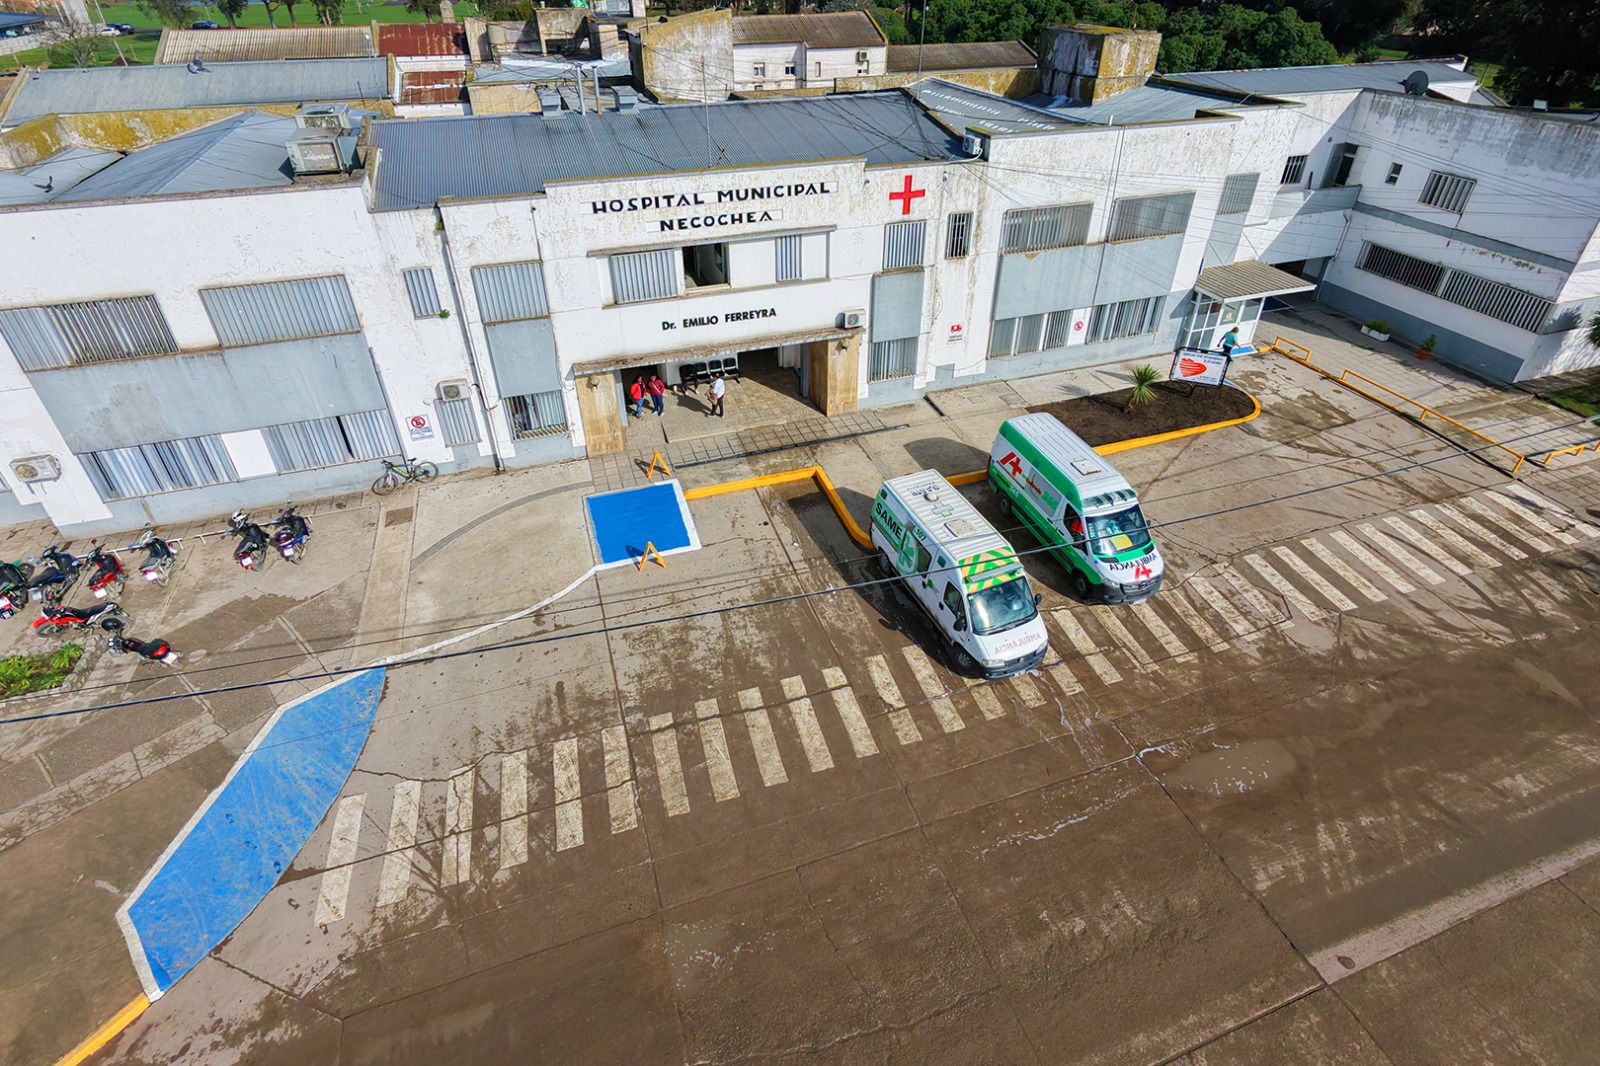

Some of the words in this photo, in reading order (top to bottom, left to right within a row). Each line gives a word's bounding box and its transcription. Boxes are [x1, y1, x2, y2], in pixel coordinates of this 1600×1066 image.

[592, 193, 705, 214] HOSPITAL
[717, 182, 830, 203] MUNICIPAL
[660, 211, 773, 231] NECOCHEA
[662, 321, 677, 331] Dr.
[683, 315, 719, 328] EMILIO
[724, 308, 777, 323] FERREYRA
[875, 502, 903, 540] SAME
